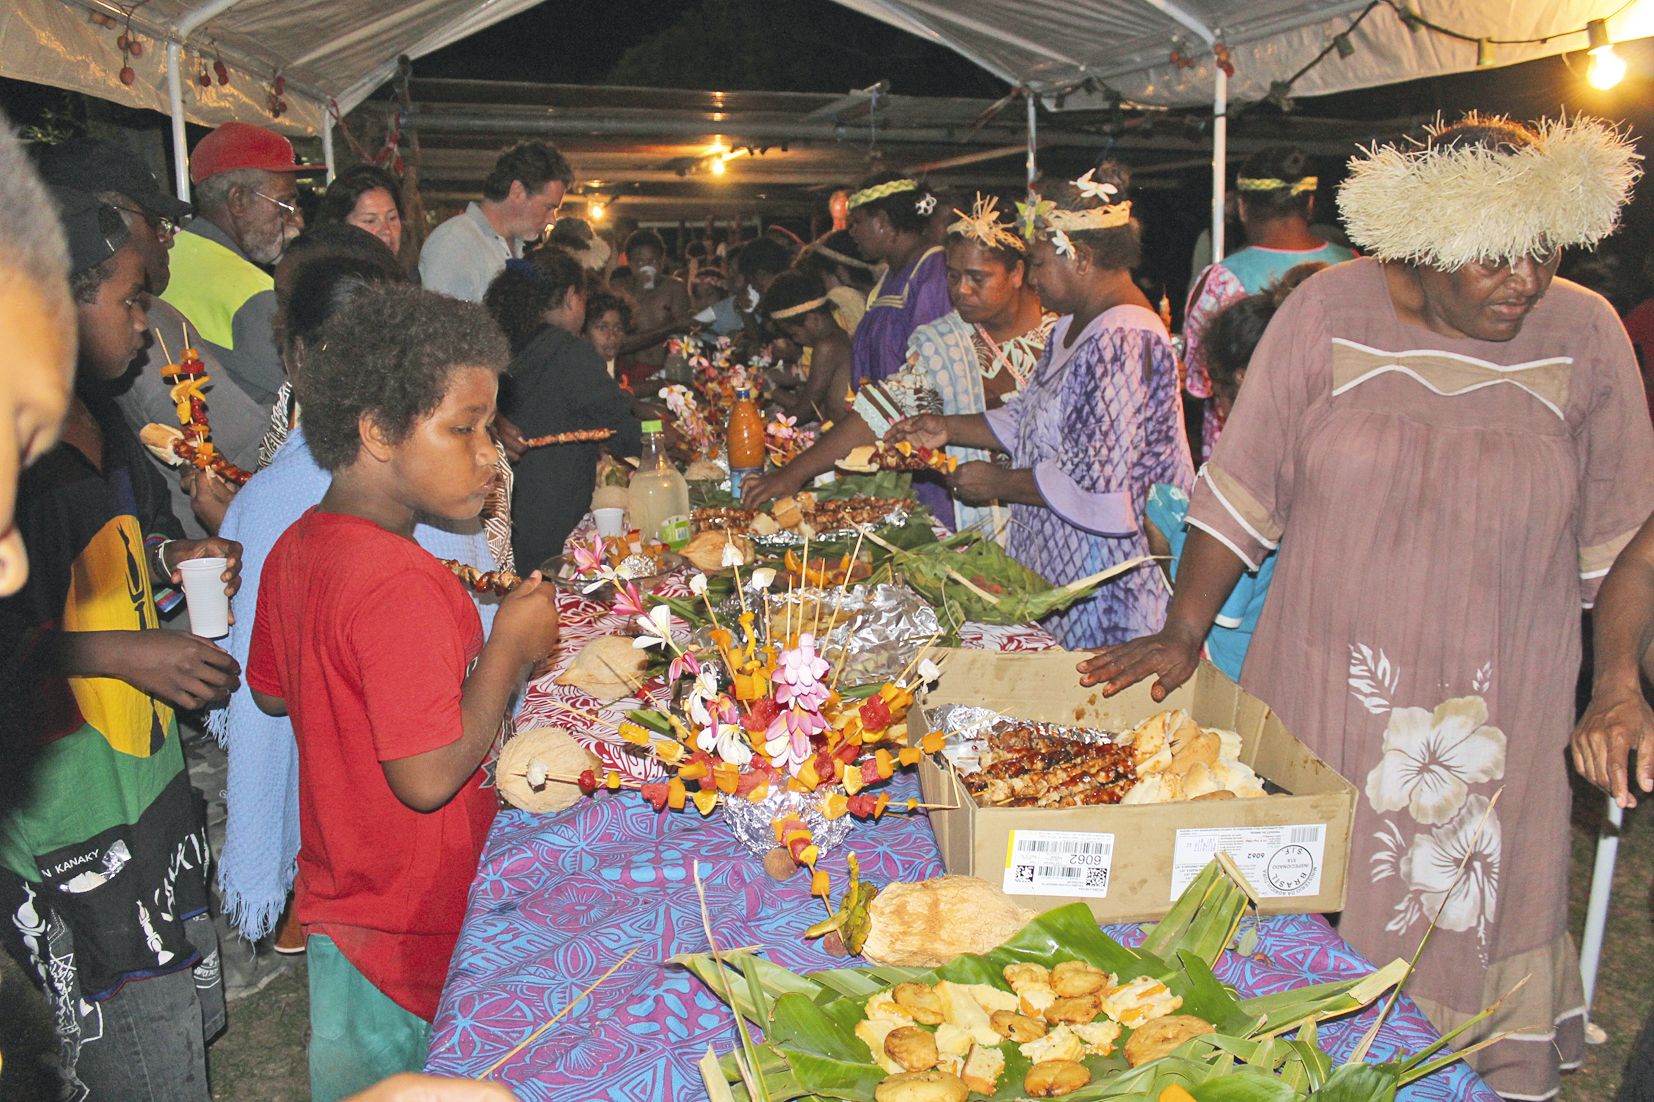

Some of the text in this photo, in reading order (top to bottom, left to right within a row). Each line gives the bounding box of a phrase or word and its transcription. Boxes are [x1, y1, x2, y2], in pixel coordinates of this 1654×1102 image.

[54, 848, 99, 874] KANAKY
[1069, 854, 1102, 865] 6062
[1272, 872, 1307, 888] BRASIL
